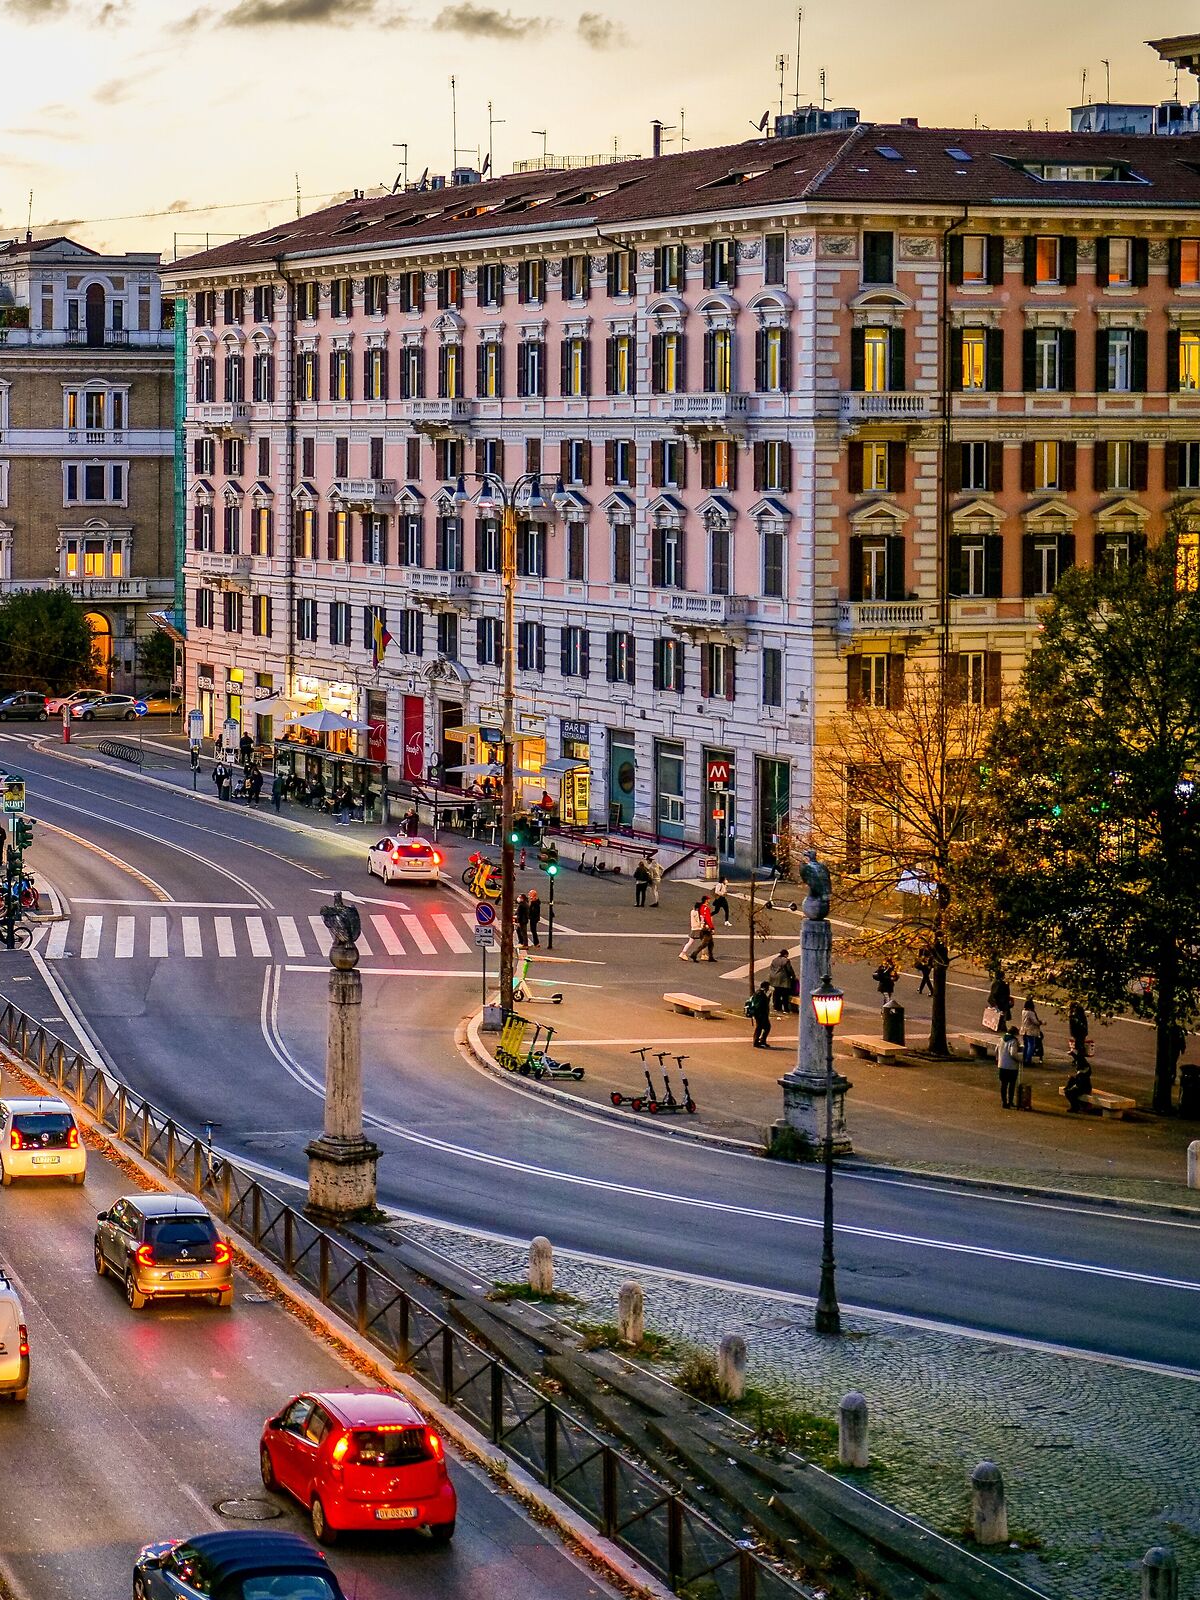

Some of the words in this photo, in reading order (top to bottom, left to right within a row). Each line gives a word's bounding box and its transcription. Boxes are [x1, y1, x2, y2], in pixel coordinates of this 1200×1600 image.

[564, 722, 579, 733] BAR
[405, 744, 419, 755] Ready?
[710, 765, 727, 778] M
